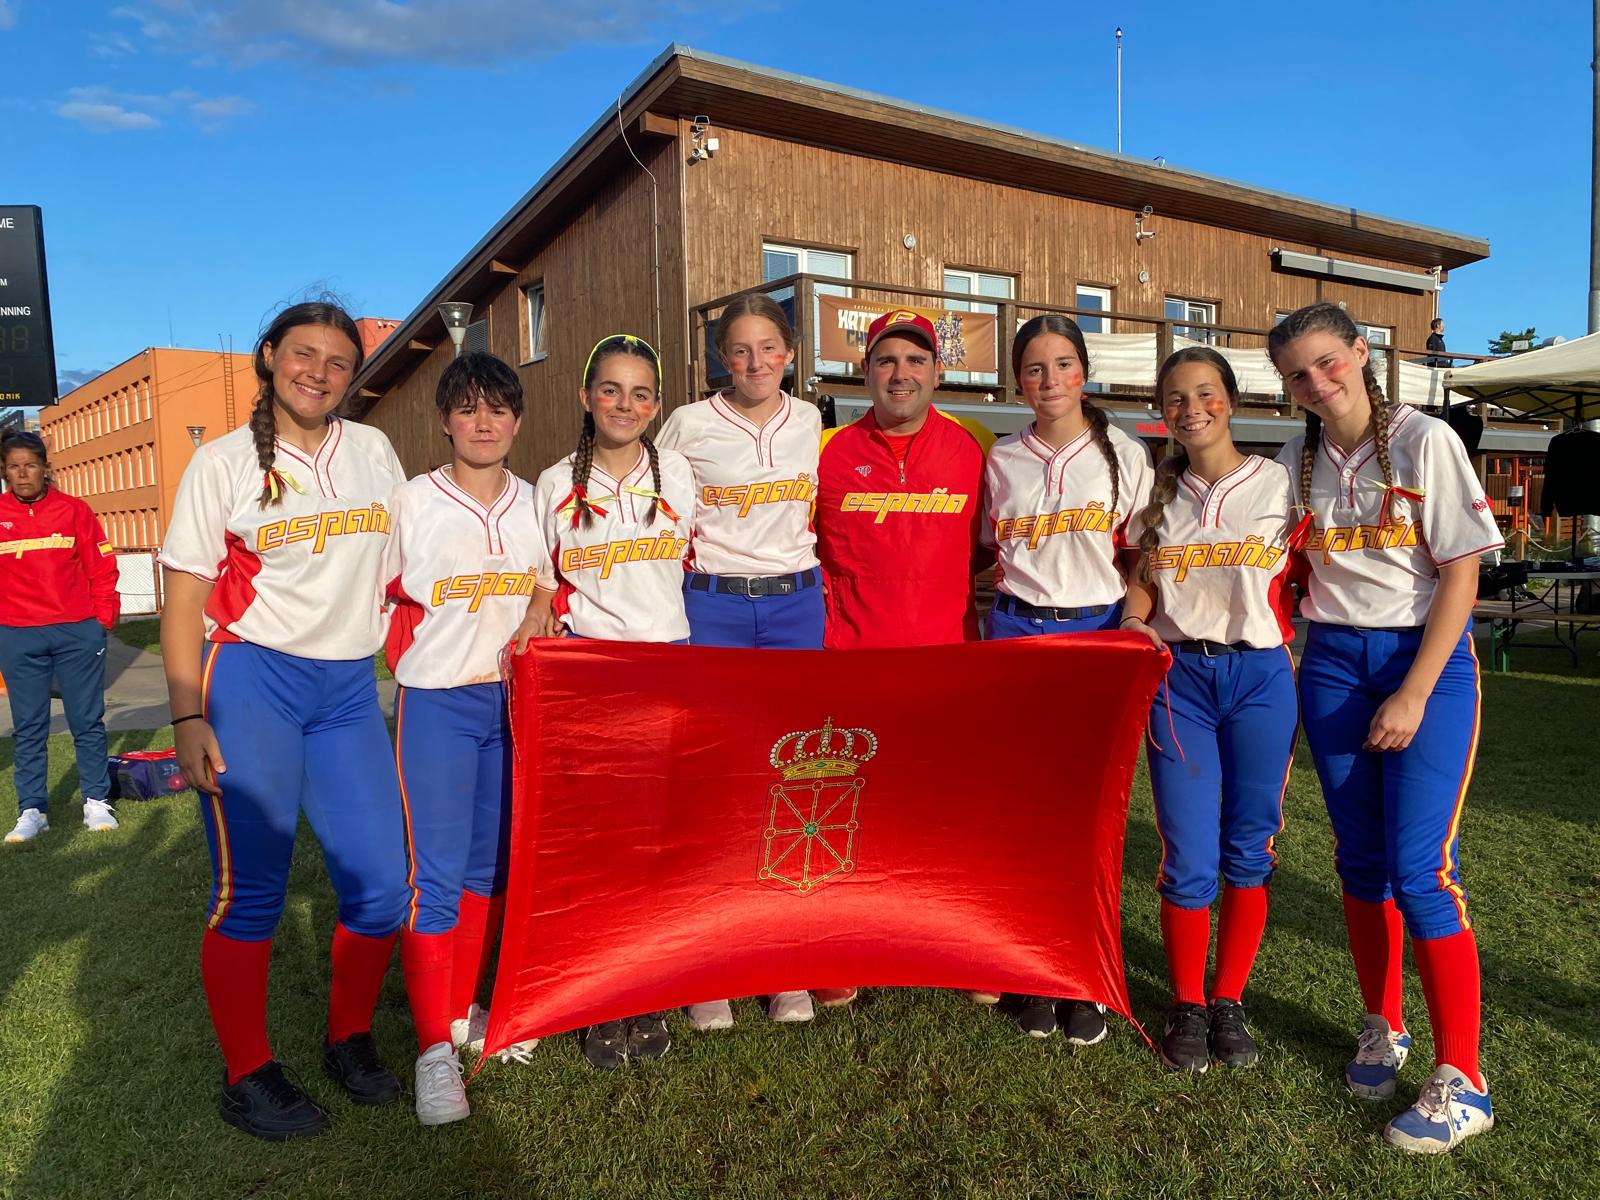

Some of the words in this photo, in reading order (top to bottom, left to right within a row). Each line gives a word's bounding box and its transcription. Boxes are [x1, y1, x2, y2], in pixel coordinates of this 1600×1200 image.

[256, 502, 391, 554] españ
[840, 487, 969, 524] españa
[1150, 535, 1285, 582] spaña
